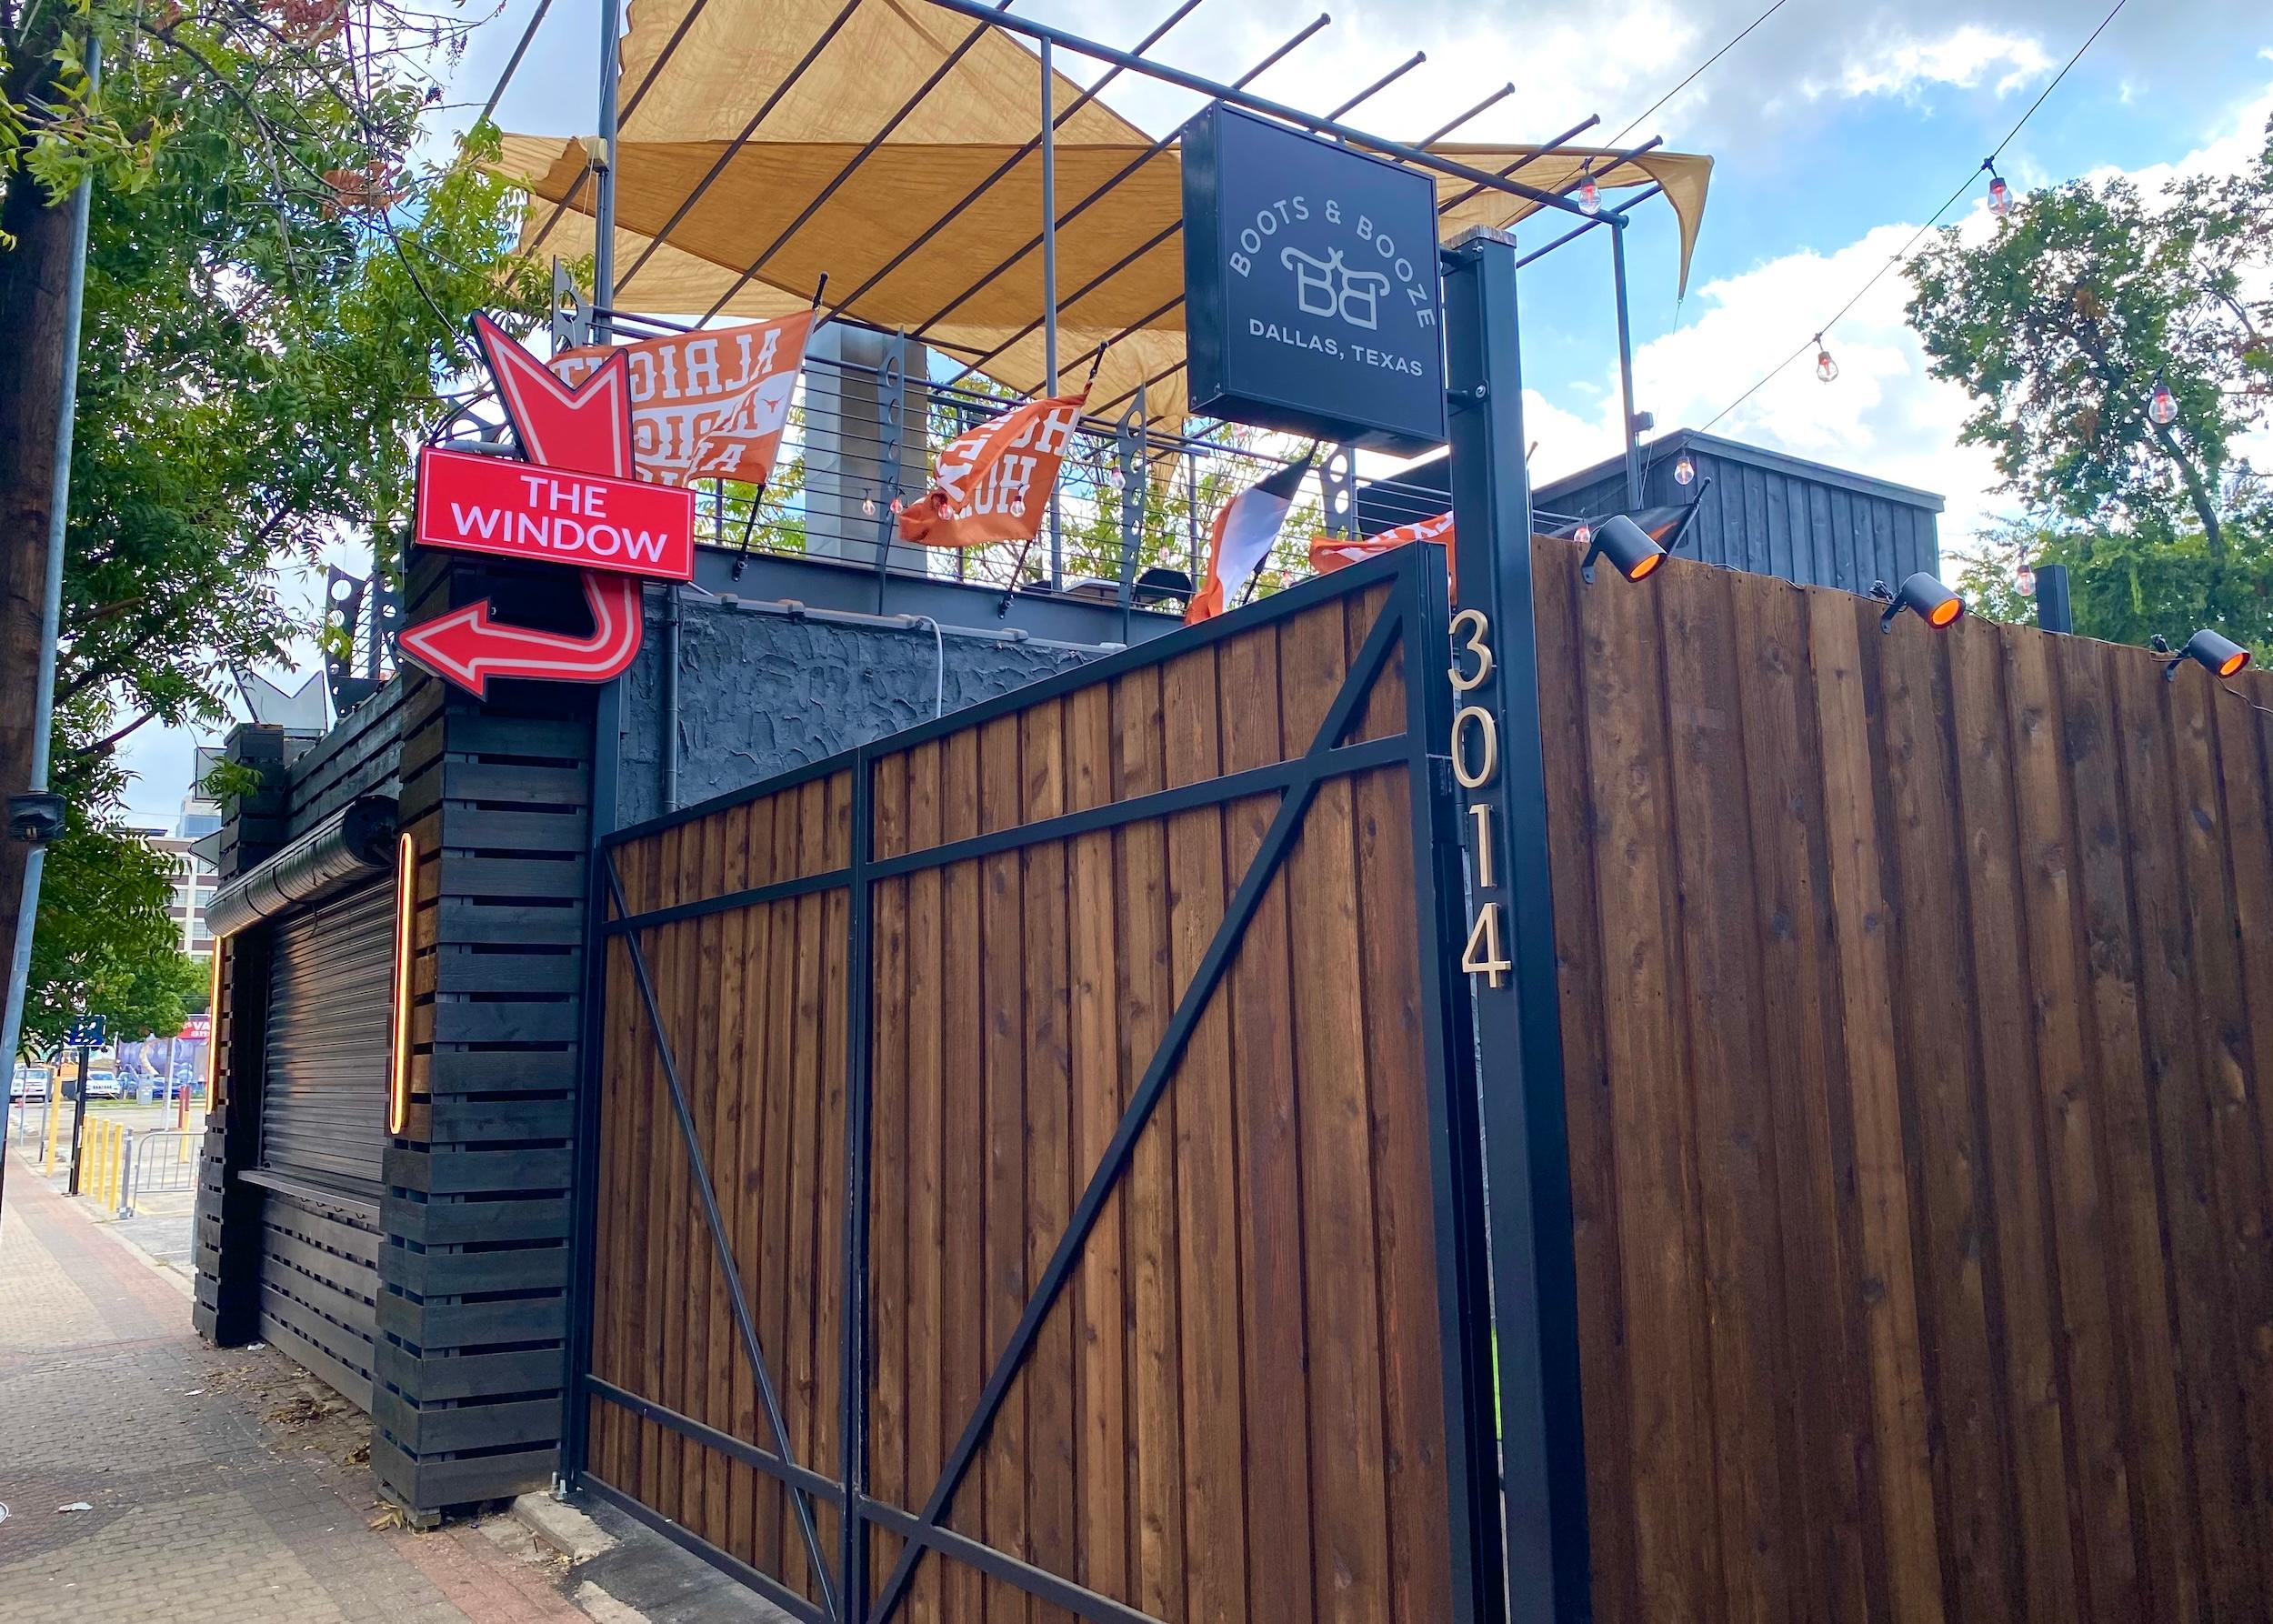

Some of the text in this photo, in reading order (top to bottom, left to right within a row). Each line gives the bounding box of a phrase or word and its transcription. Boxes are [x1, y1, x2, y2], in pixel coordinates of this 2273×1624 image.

[1229, 195, 1436, 328] BOOTS & BOOZE
[1248, 317, 1424, 377] DALLAS, TEXAS
[520, 475, 608, 518] THE
[450, 502, 668, 563] WINDOW
[1447, 608, 1512, 988] 3014
